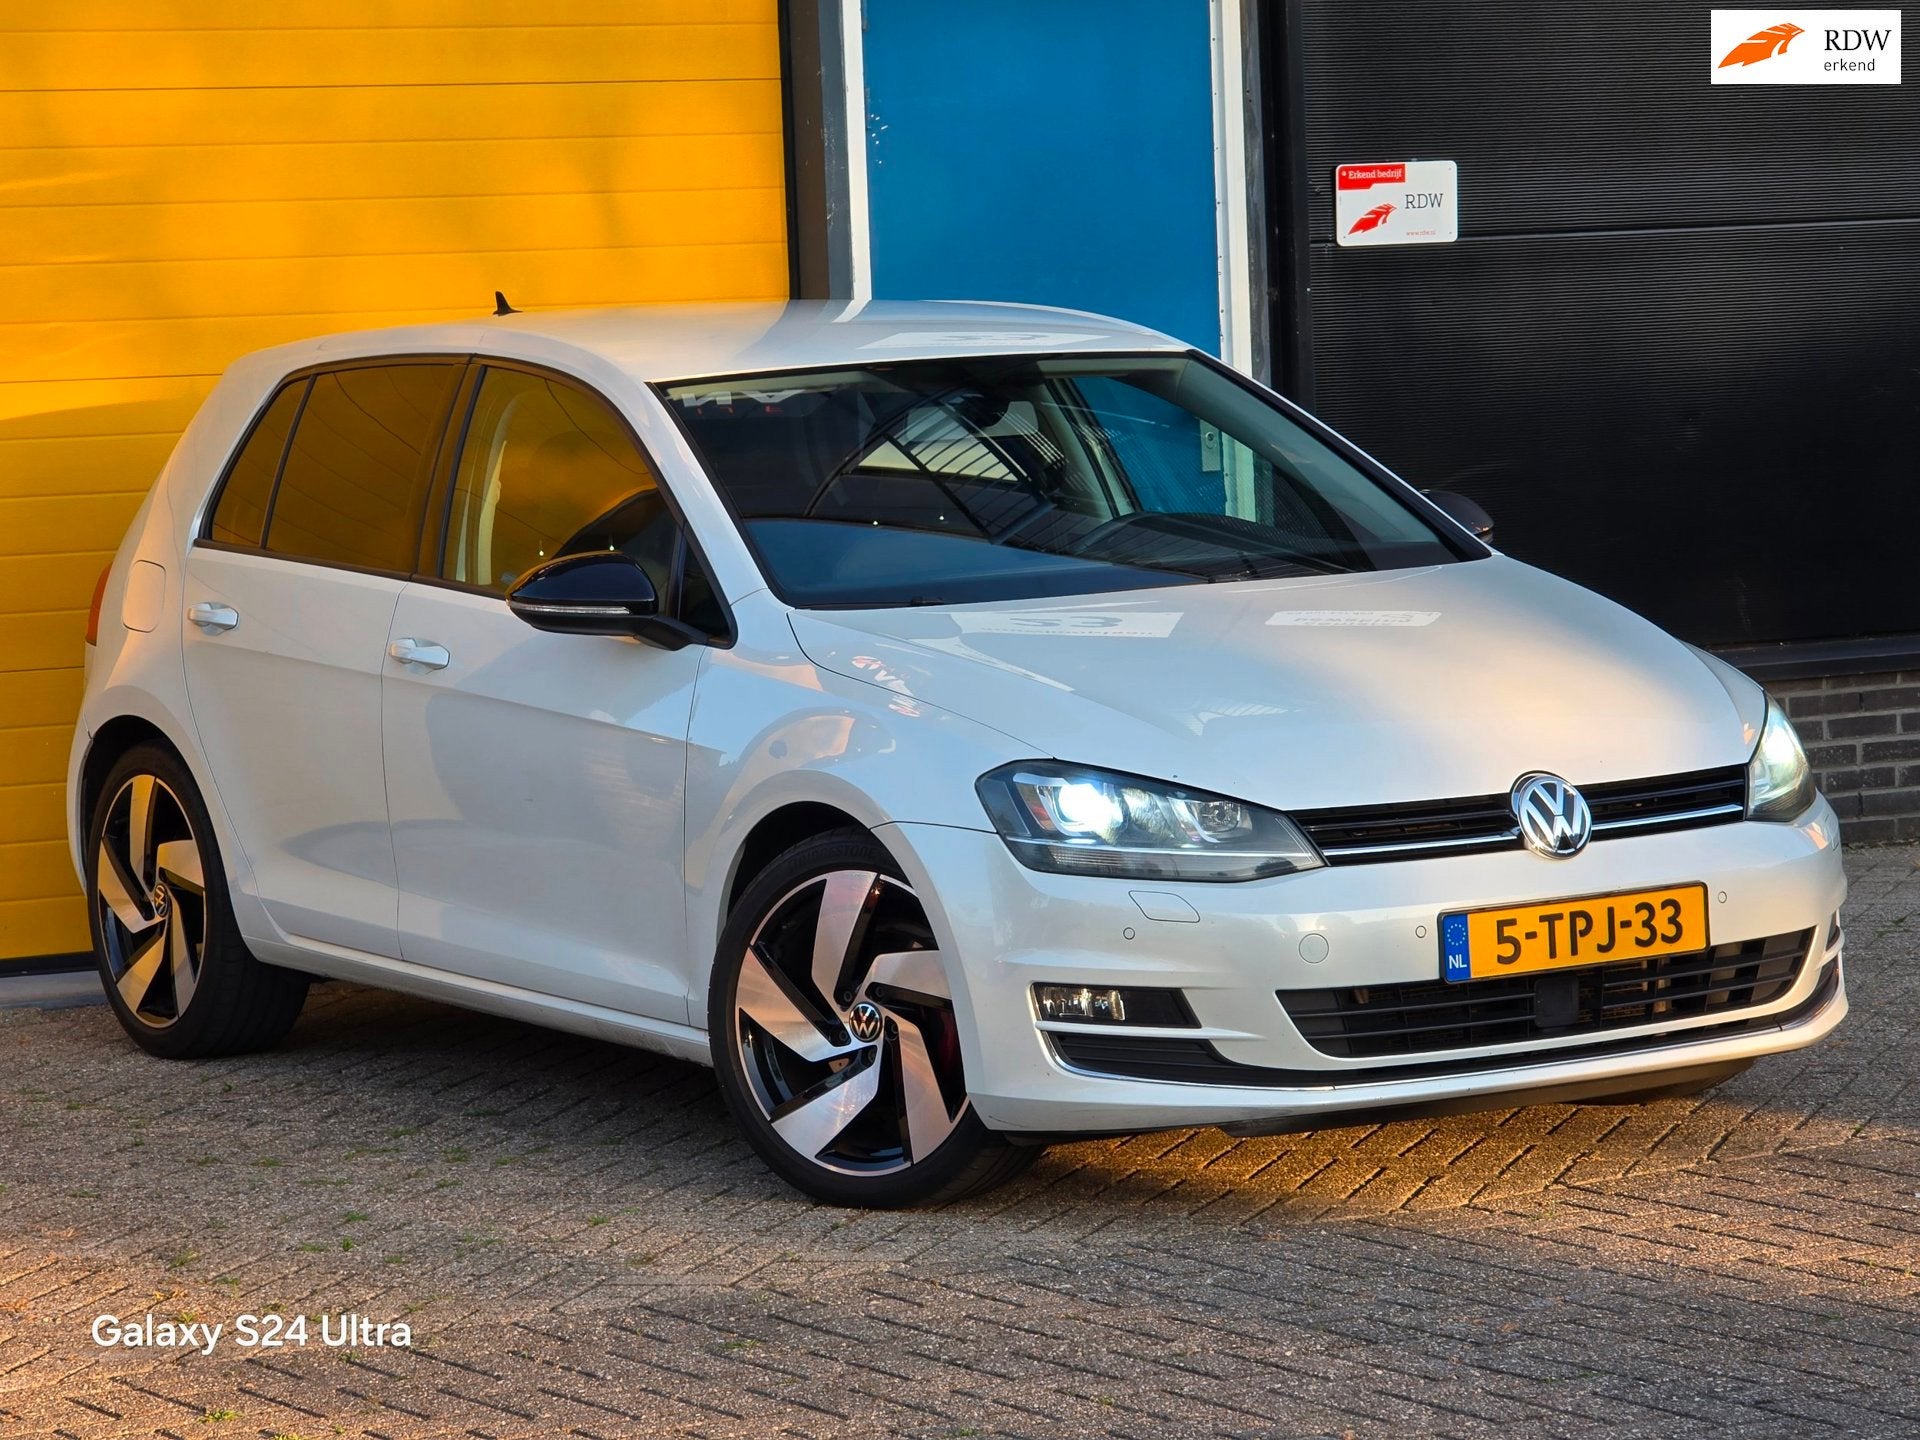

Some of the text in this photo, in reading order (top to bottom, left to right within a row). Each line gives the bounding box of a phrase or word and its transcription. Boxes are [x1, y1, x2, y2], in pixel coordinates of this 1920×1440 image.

[1348, 168, 1402, 180] Erkend bedrijf
[1405, 193, 1444, 209] RDW
[1518, 774, 1591, 858] VW
[1496, 898, 1683, 965] 5-TPJ-33
[1448, 954, 1467, 970] NL
[850, 1003, 882, 1041] VW
